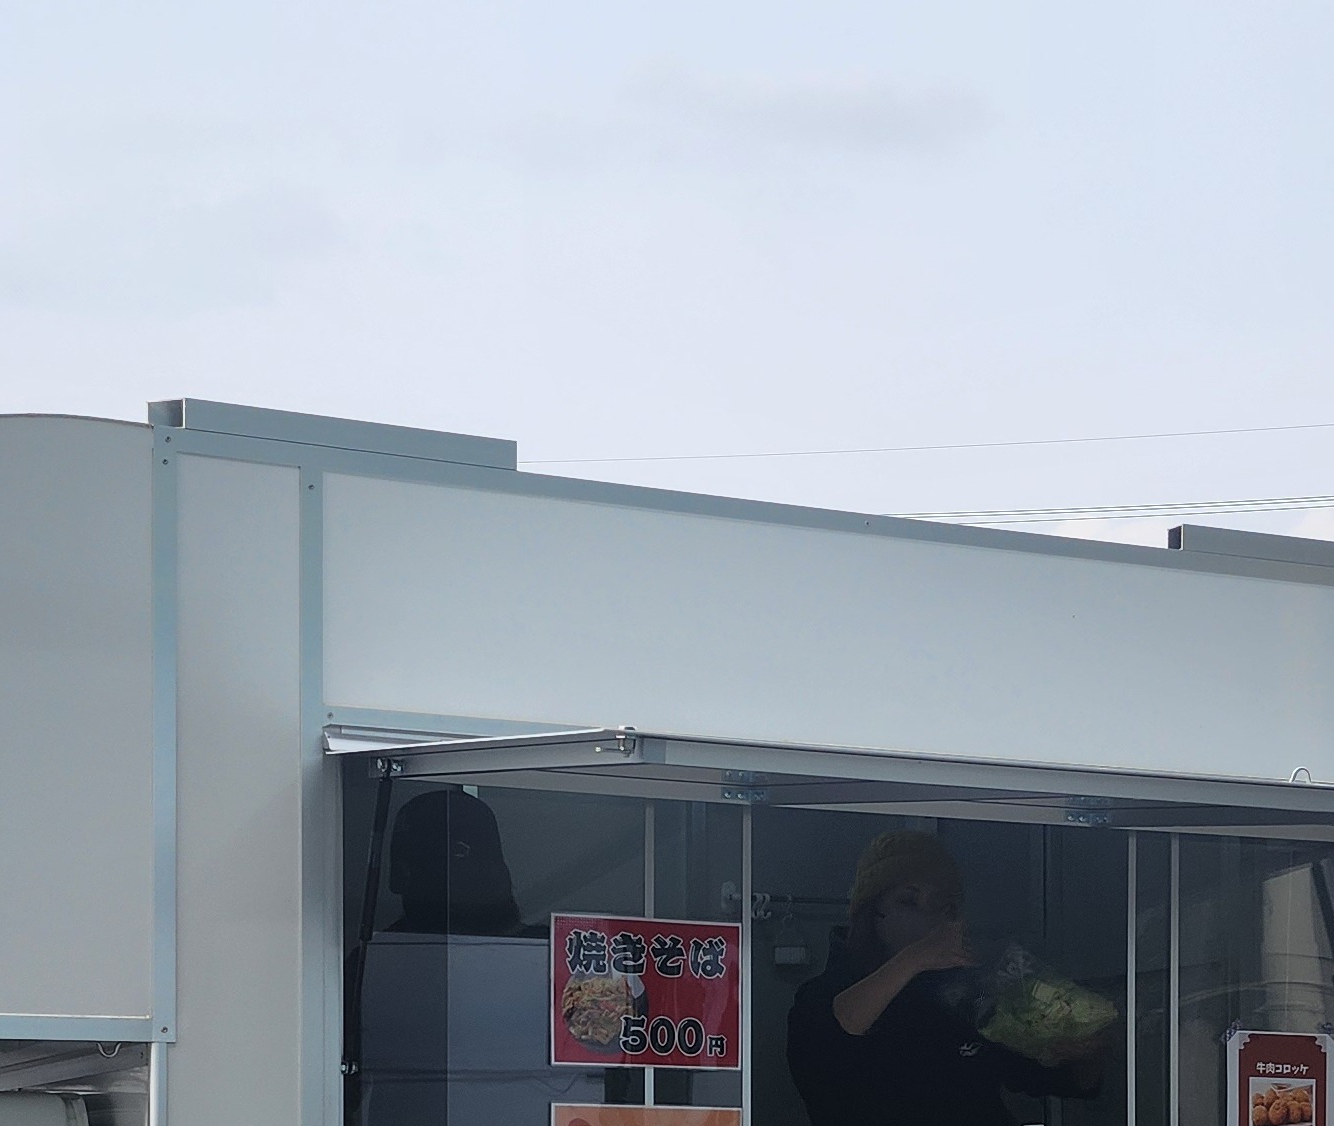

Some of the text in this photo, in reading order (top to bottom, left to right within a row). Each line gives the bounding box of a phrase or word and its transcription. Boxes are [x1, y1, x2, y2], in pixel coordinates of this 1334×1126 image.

[565, 928, 727, 980] 焼きそば
[619, 1015, 727, 1057] 500円
[1256, 1061, 1309, 1075] 牛肉コロッケ
